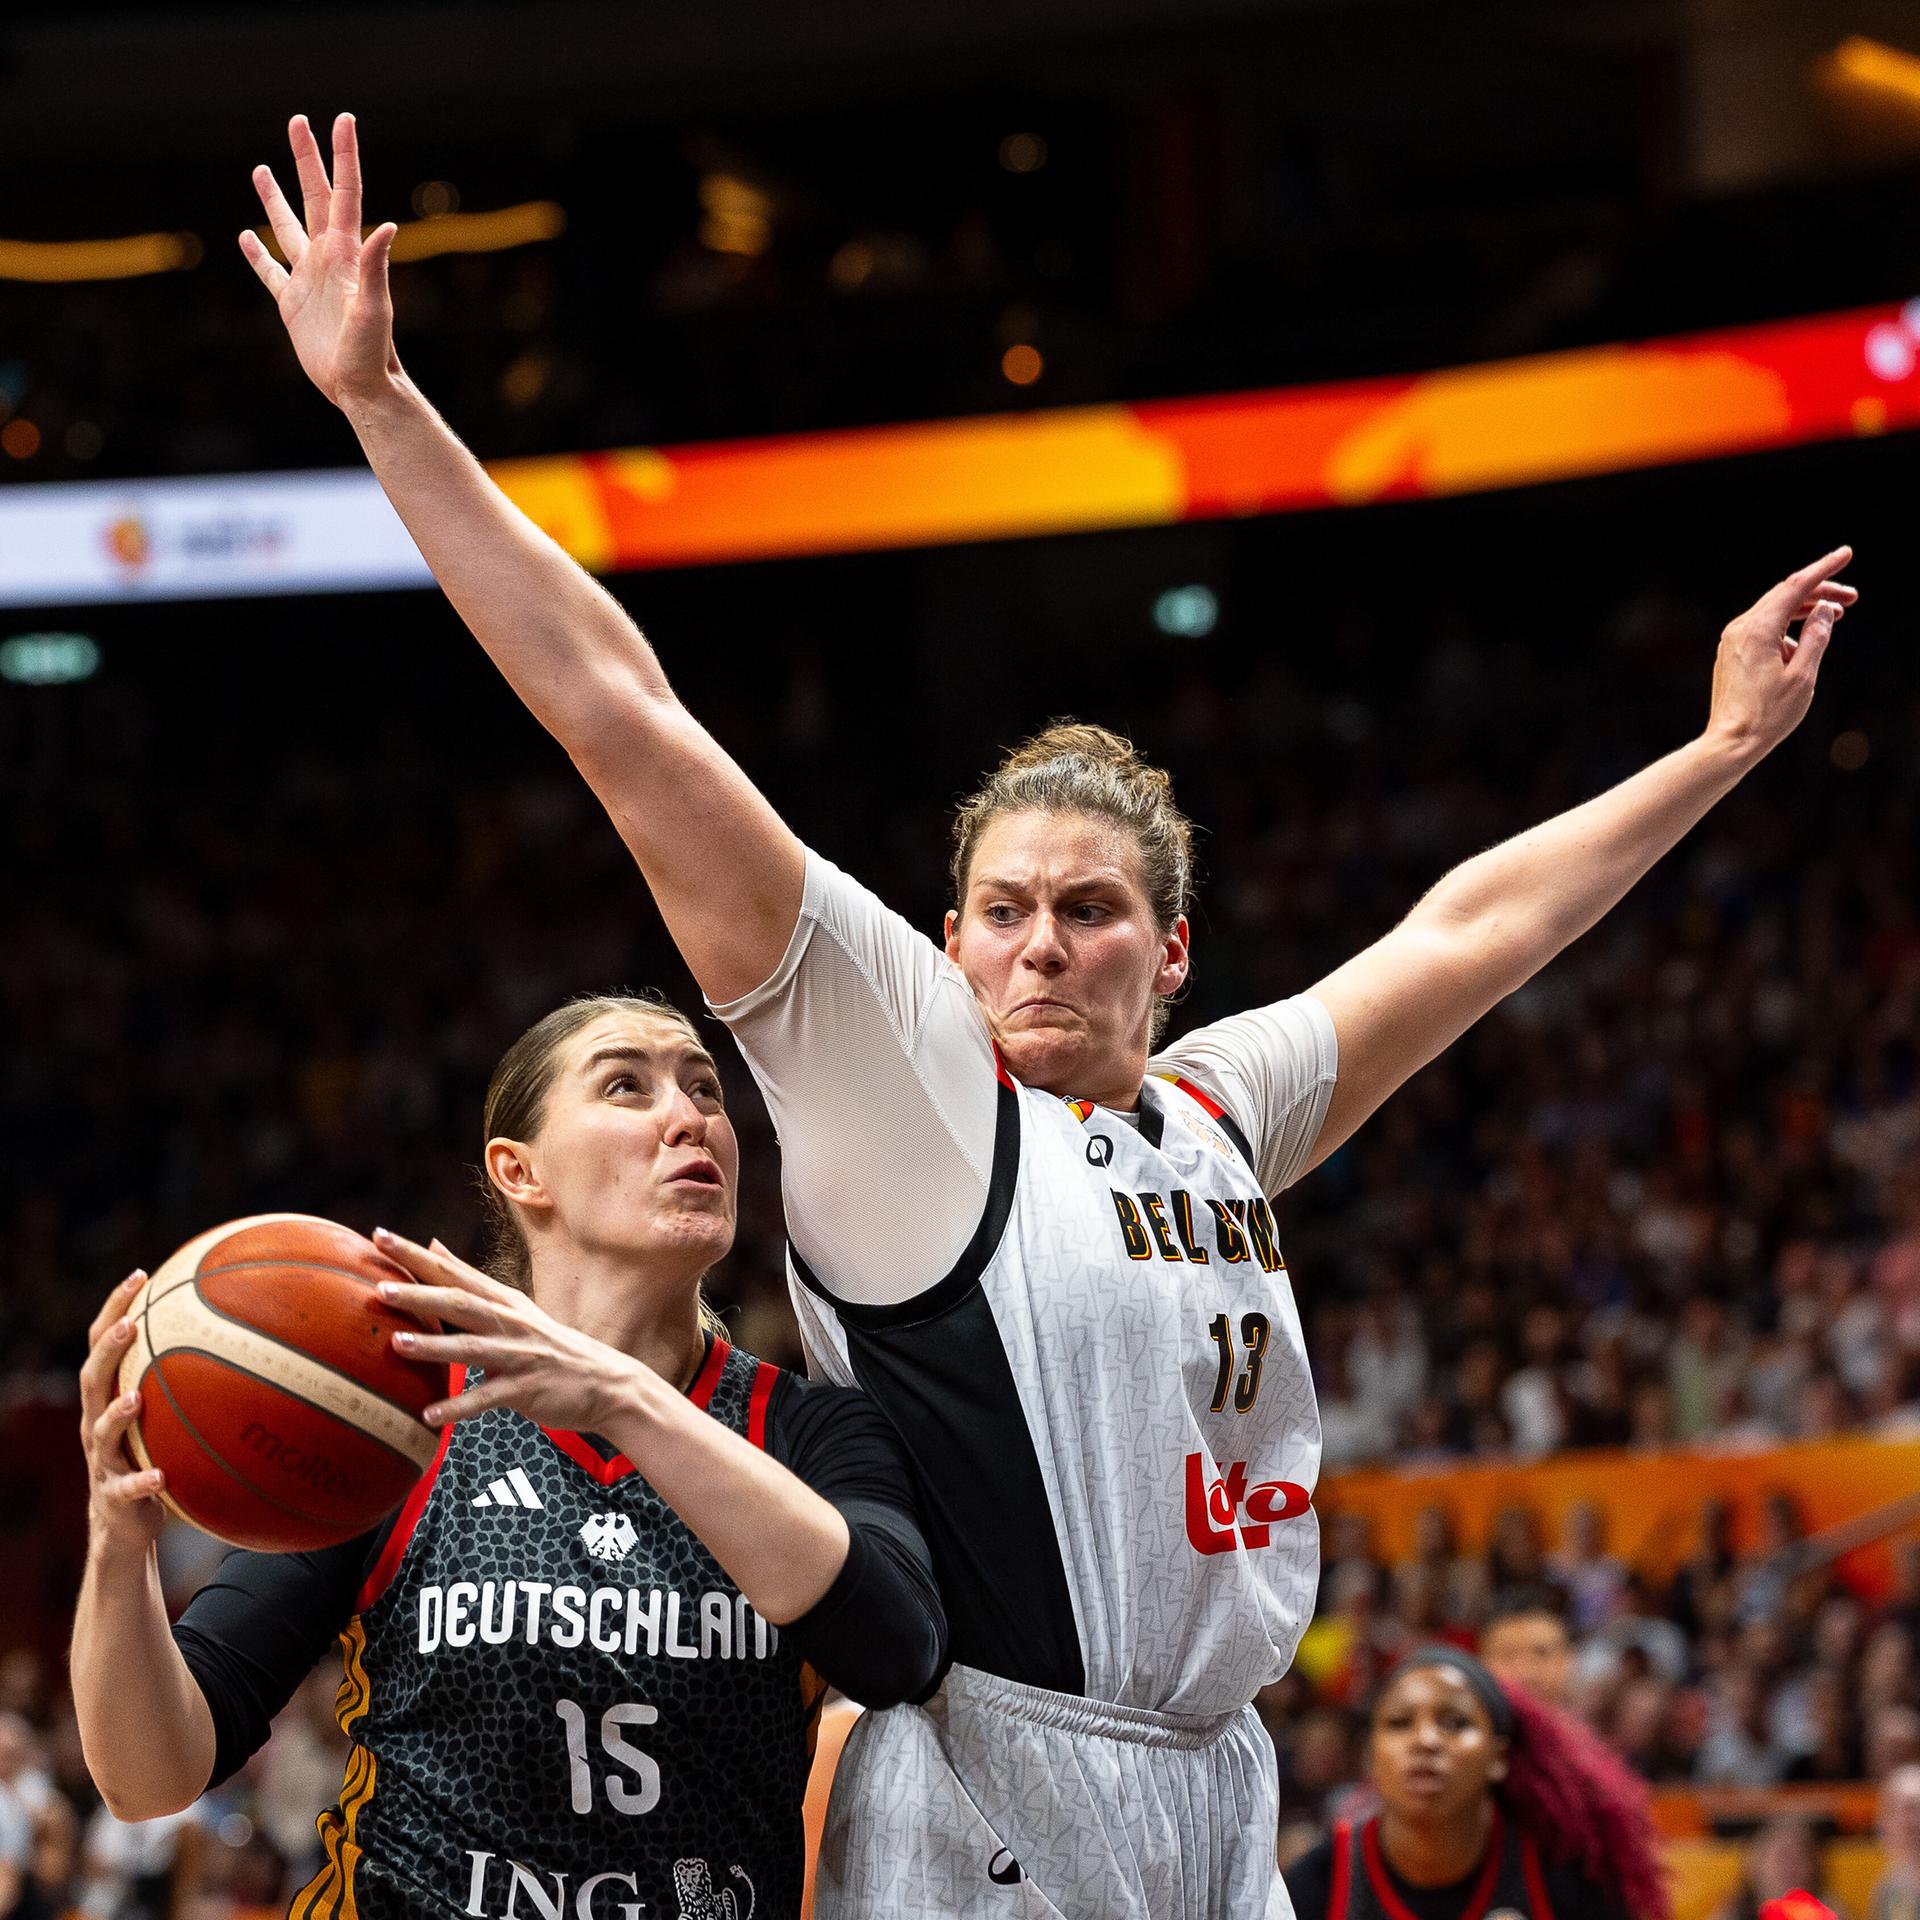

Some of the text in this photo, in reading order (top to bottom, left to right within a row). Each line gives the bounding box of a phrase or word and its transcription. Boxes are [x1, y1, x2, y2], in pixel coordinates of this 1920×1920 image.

[1208, 1312, 1271, 1414] 13
[239, 1422, 366, 1502] molte
[1185, 1452, 1311, 1555] Loto
[418, 1580, 778, 1660] DEUTSCHLAN
[556, 1699, 661, 1815] 15
[465, 1850, 646, 1920] ING
